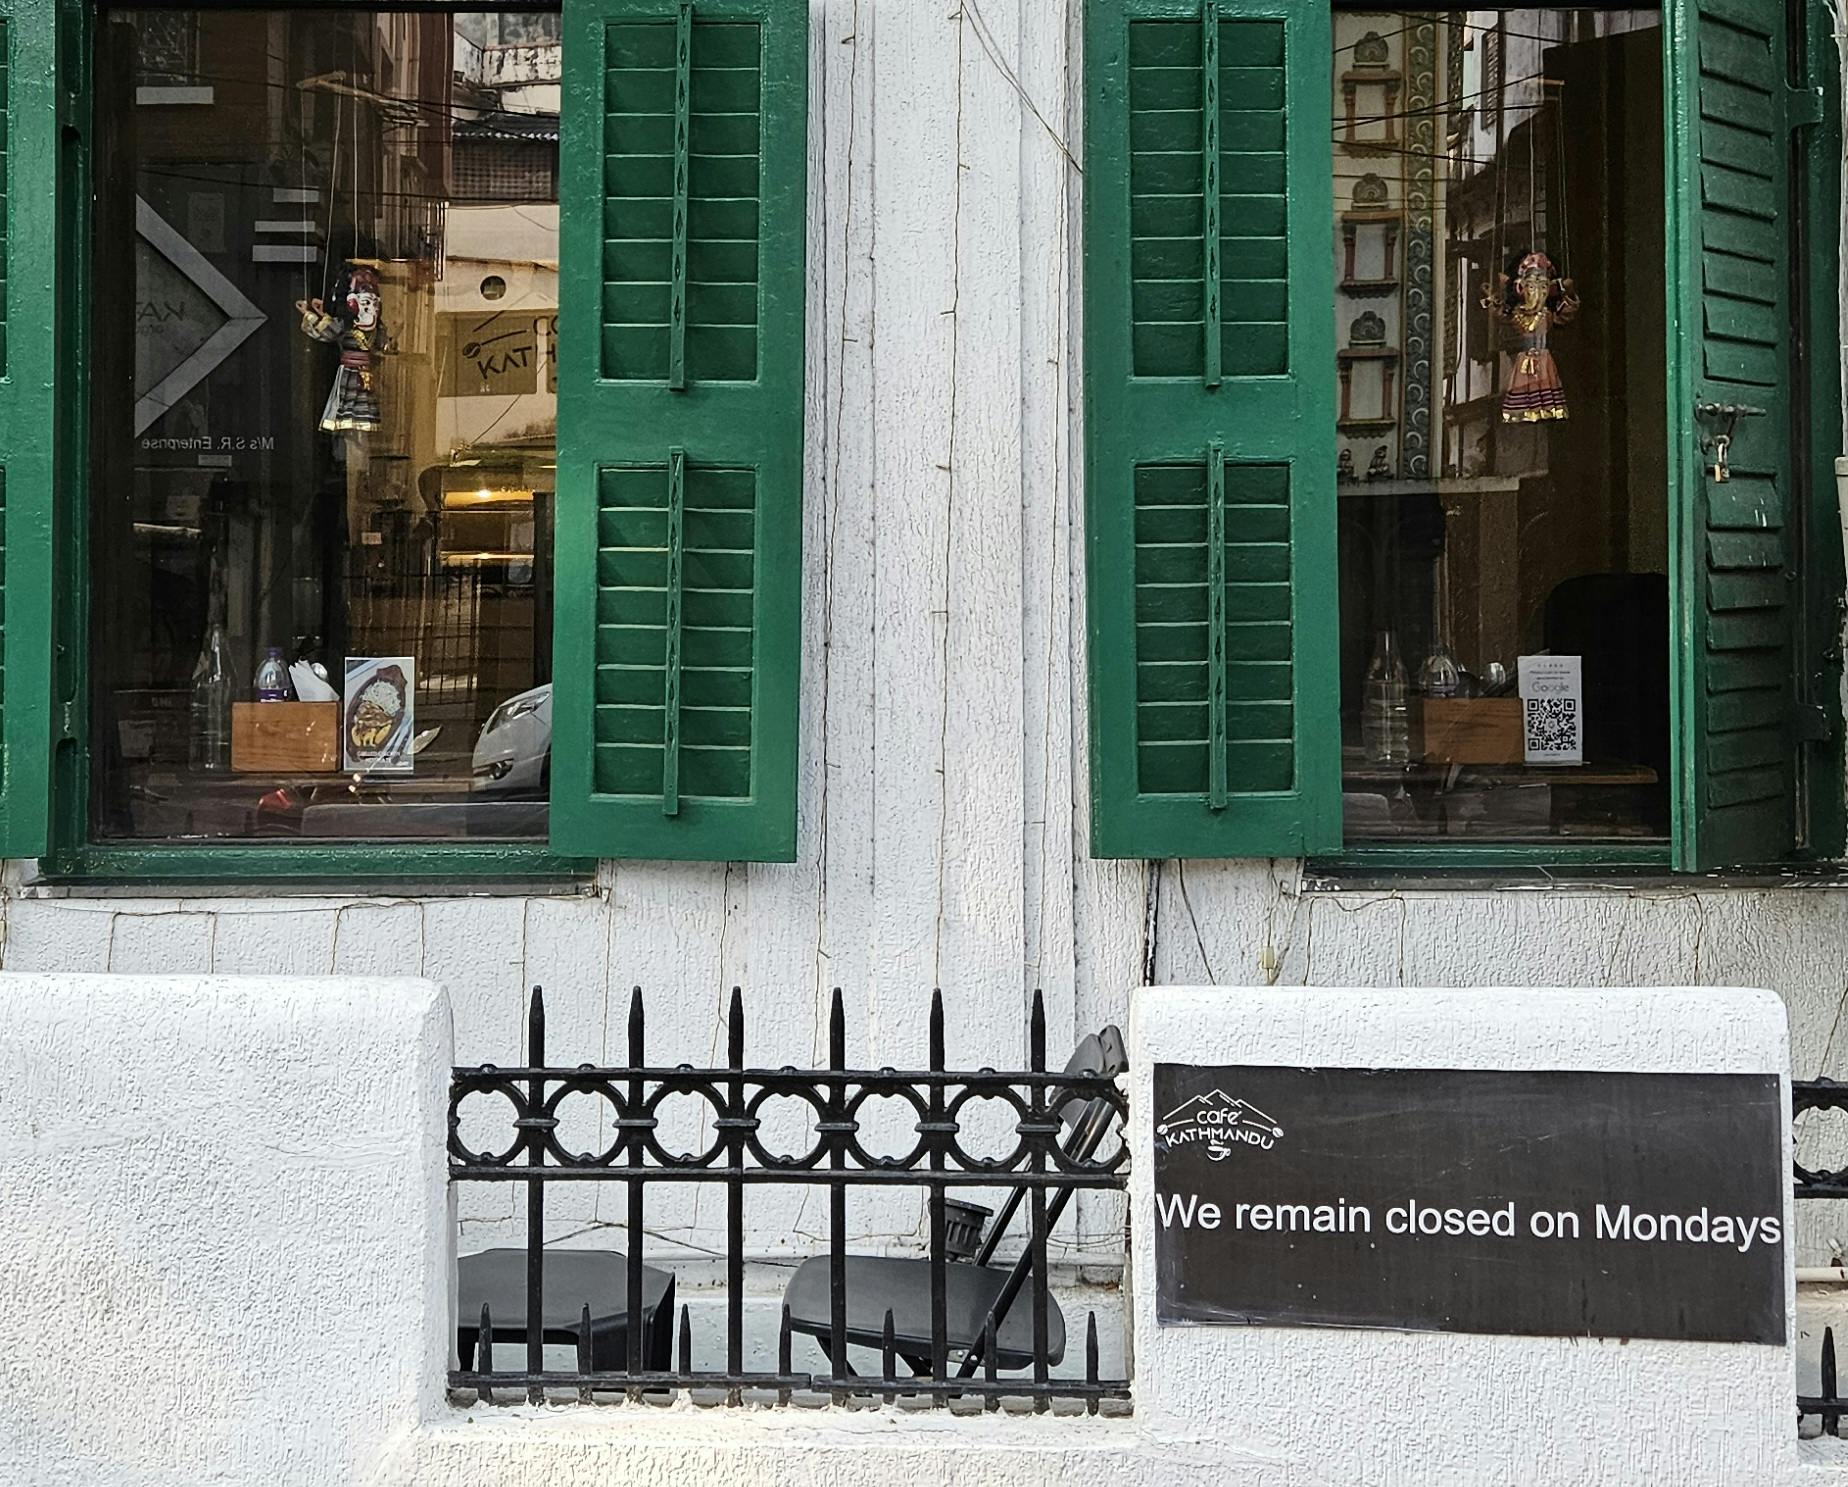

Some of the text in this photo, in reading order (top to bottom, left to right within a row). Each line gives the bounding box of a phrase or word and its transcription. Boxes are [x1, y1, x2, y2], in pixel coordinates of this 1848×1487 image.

[1165, 1127, 1274, 1150] KATHMANDU
[1156, 1193, 1782, 1253] We remain closed on Mondays
